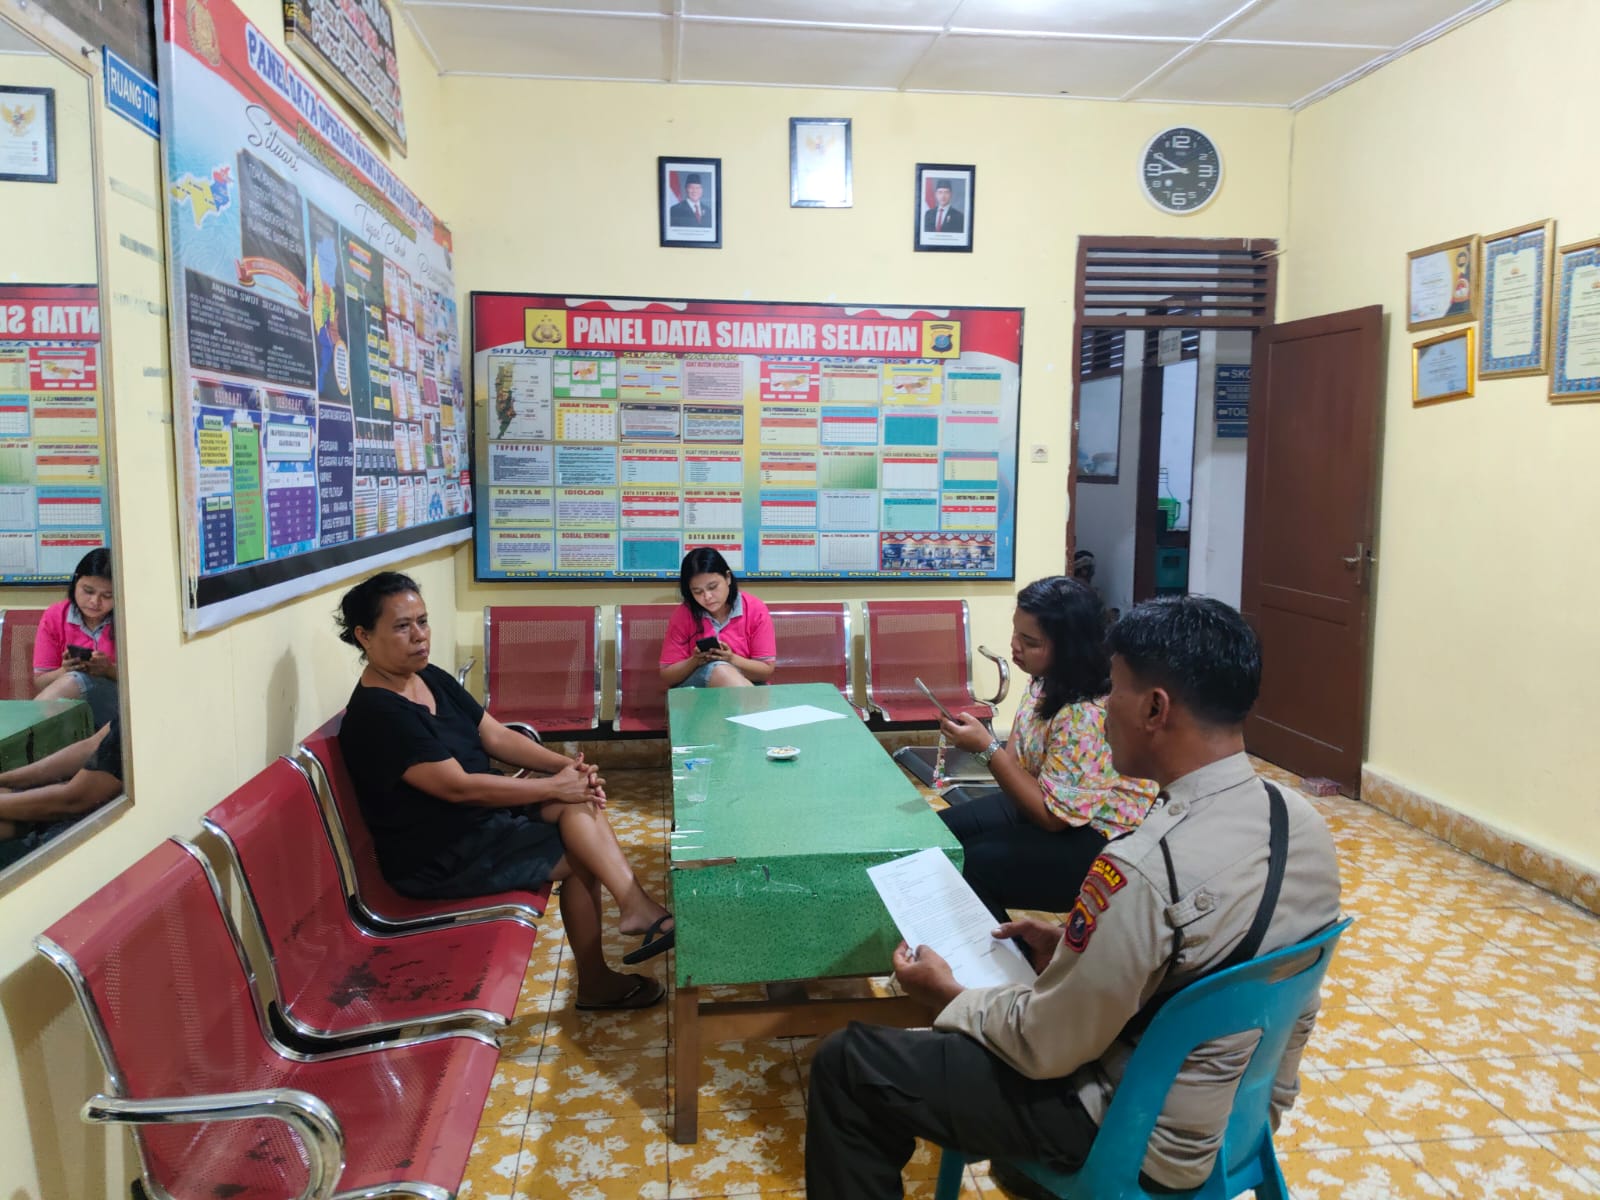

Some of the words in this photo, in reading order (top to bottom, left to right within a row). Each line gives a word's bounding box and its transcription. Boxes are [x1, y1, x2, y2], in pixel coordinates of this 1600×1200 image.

[247, 26, 290, 98] PANEL
[289, 71, 318, 126] DATA
[111, 67, 142, 110] RUANG
[1172, 135, 1191, 148] 12
[1147, 163, 1161, 176] 9
[1198, 164, 1213, 177] 3
[1171, 192, 1187, 205] 6
[573, 316, 646, 346] PANEL
[652, 319, 714, 347] DATA
[716, 321, 816, 350] SIANTAR
[821, 323, 918, 352] SELATAN
[491, 347, 547, 356] SITUASI
